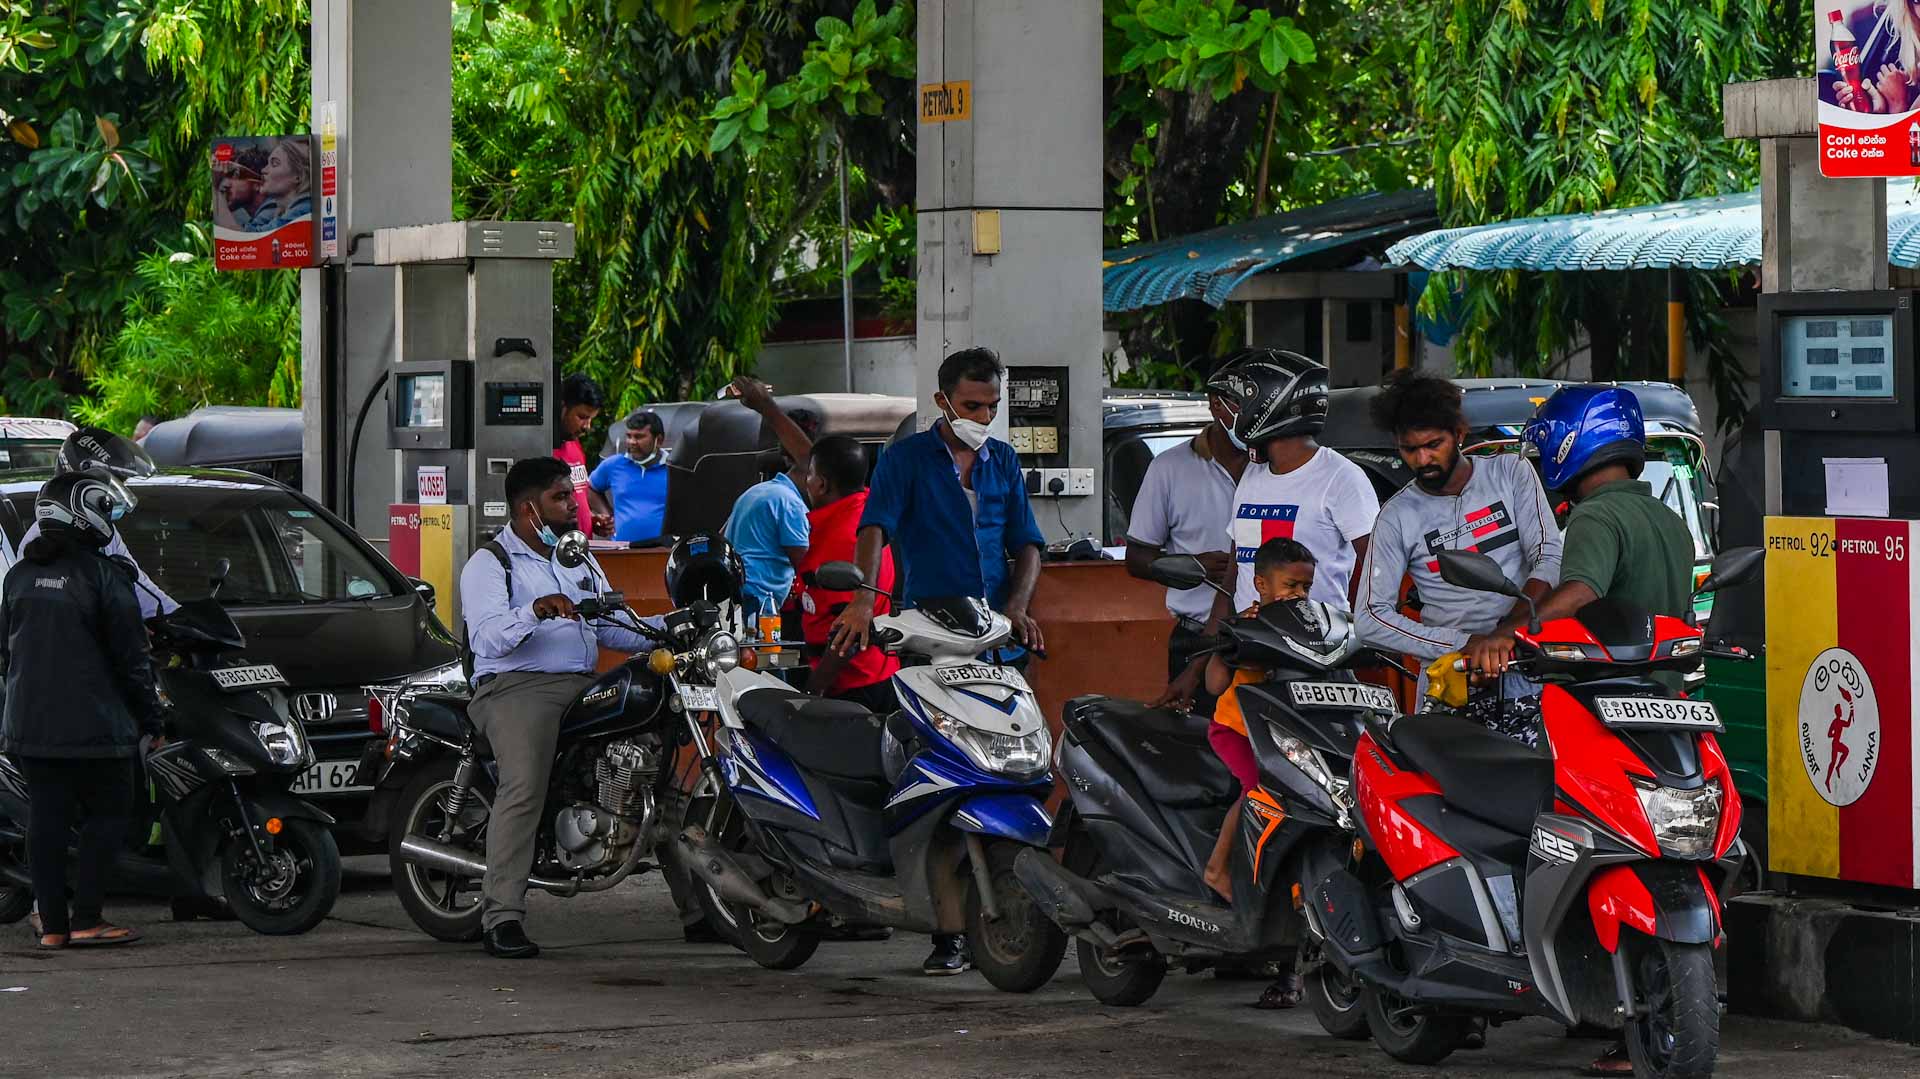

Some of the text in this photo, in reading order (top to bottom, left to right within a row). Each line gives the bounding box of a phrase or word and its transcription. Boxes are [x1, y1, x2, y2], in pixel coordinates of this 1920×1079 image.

[923, 88, 963, 117] PETROL 9
[1826, 134, 1855, 146] Cool
[1826, 147, 1858, 158] Coke
[78, 436, 111, 463] ACTIVE
[420, 475, 445, 496] CLOSED
[391, 513, 418, 530] PETROL 95
[423, 513, 451, 530] PETROL 92
[1240, 507, 1292, 517] TOMMY
[1432, 511, 1503, 546] TOMMY HILFIGER
[1237, 550, 1257, 559] HILF
[1769, 532, 1829, 557] PETROL 92
[1841, 535, 1905, 561] PETROL 95
[226, 667, 281, 683] BGT2414
[1815, 659, 1864, 699] ලංකා
[583, 687, 617, 704] SUZUKI
[1622, 702, 1715, 721] BHS8963
[1858, 731, 1876, 782] LANKA
[291, 766, 322, 791] AH
[1537, 828, 1579, 862] 125
[1168, 909, 1219, 933] HONDA
[1508, 980, 1521, 990] TVS
